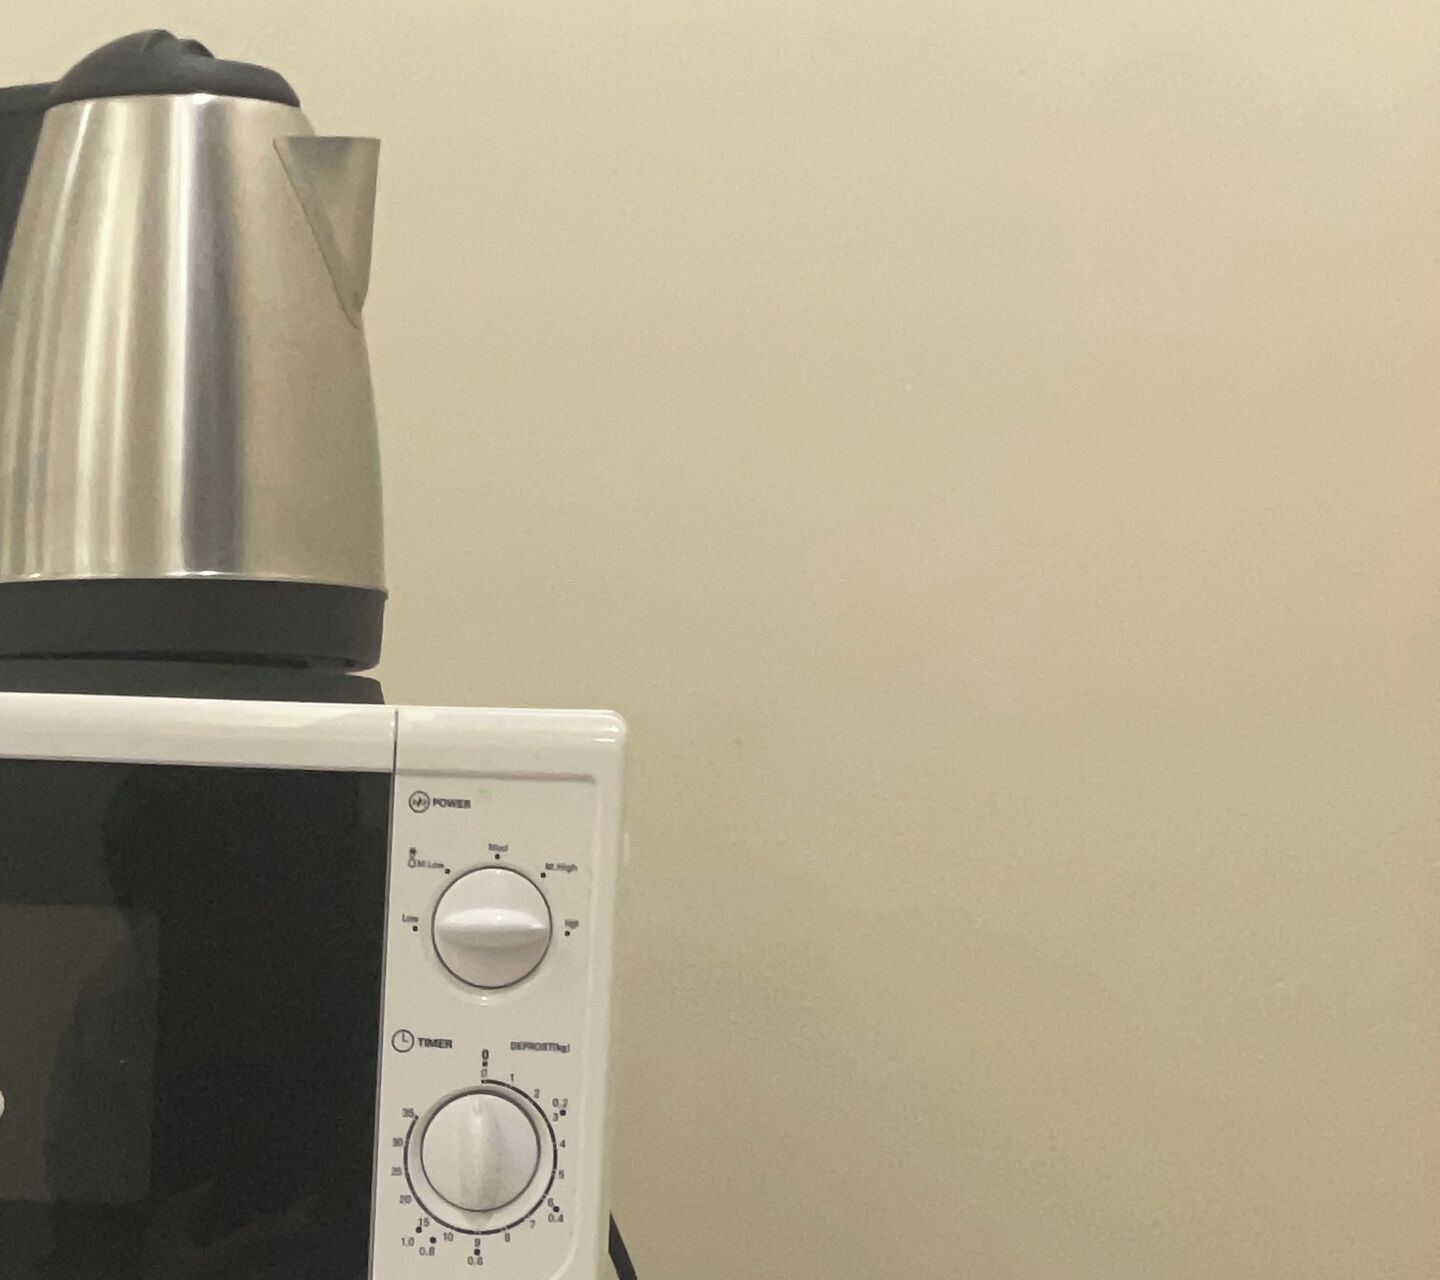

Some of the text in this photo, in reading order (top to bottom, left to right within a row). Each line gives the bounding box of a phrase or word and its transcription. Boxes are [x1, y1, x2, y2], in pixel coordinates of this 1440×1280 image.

[432, 797, 472, 809] POWER
[417, 1037, 453, 1049] TIMER
[418, 1217, 430, 1227] 15
[443, 1232, 454, 1242] 10
